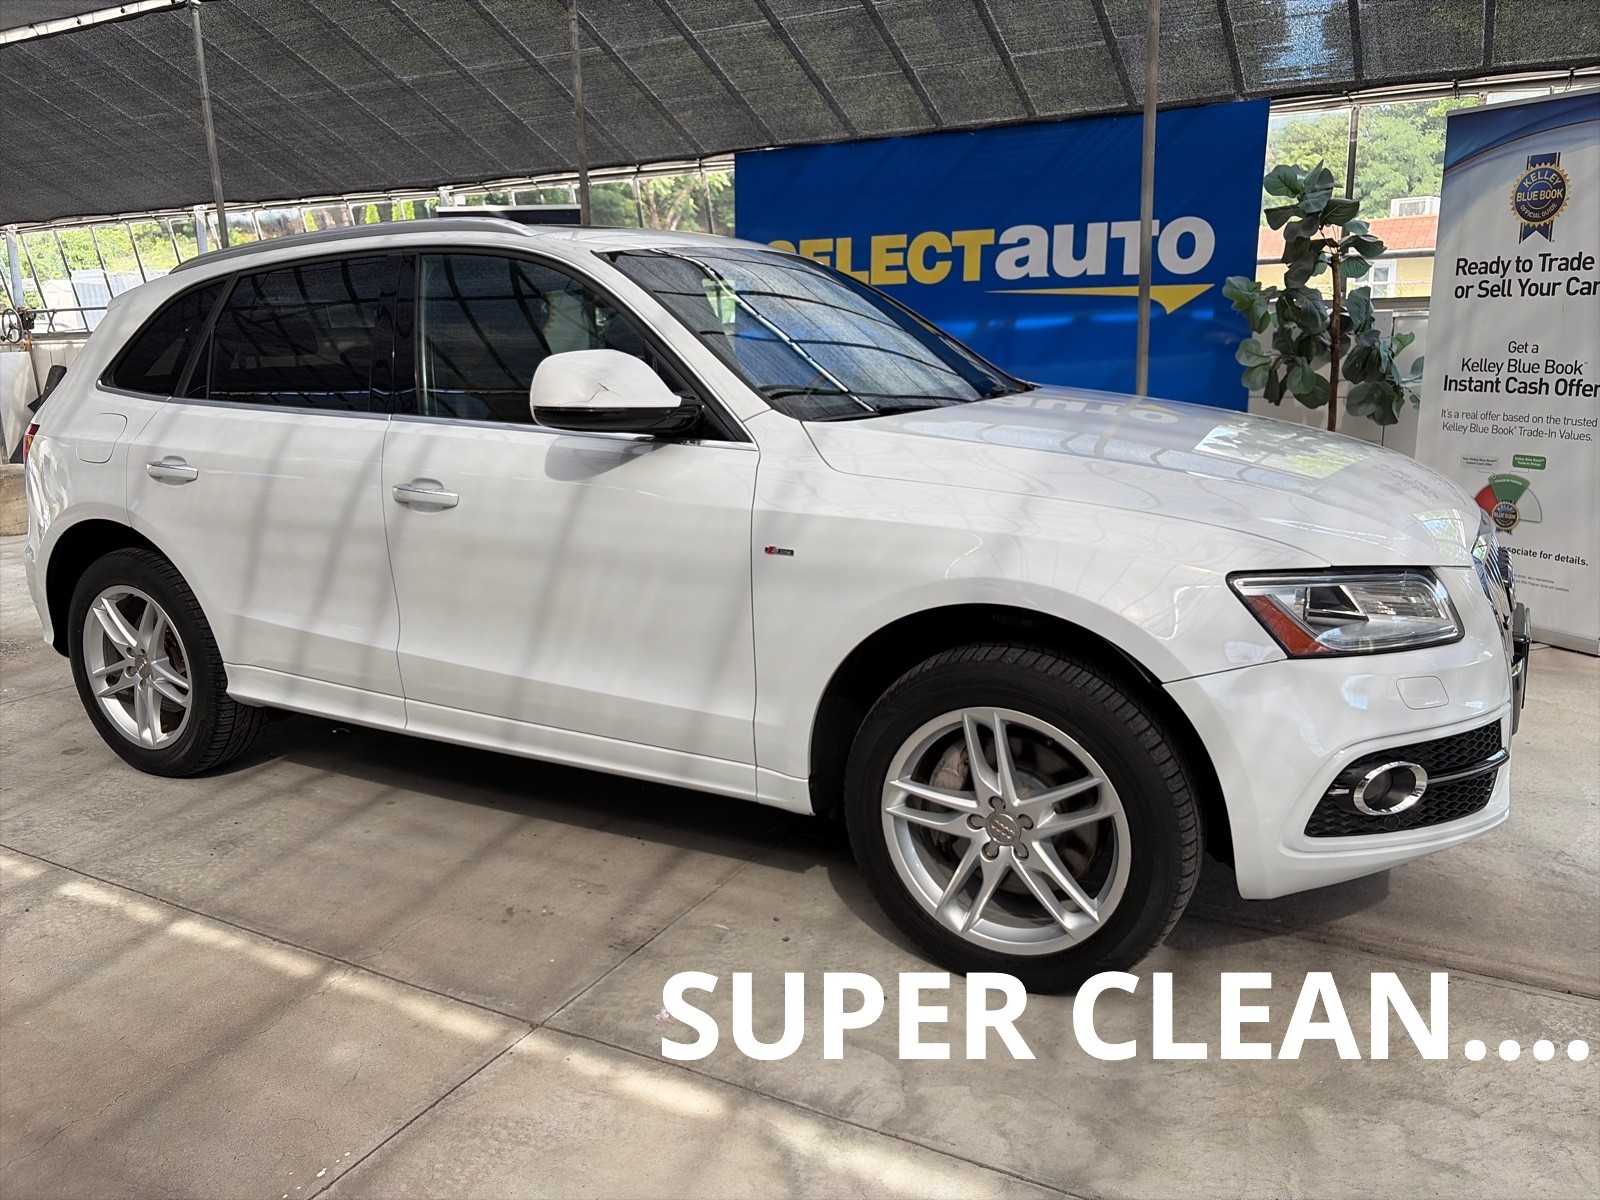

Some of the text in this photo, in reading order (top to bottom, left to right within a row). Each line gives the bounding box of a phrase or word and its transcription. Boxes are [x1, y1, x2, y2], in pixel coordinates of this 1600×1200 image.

[1522, 170, 1562, 188] KELLEY
[1516, 188, 1564, 202] BLUE BOOK
[1520, 202, 1558, 218] OFFICIAL GUIDE
[1455, 251, 1595, 278] Ready to Trade
[1454, 276, 1600, 299] or Sell Your Car
[1508, 341, 1539, 354] Get a
[1461, 358, 1504, 376] Kelley
[1507, 358, 1540, 374] Blue
[1443, 375, 1501, 393] Instant
[1505, 376, 1549, 395] Cash
[1441, 408, 1598, 428] It's a real offer based on the trusted
[1442, 422, 1468, 434] Kelley
[1469, 423, 1490, 434] Blue
[1519, 427, 1557, 439] Trade-In
[1559, 429, 1593, 442] Values.
[1539, 550, 1553, 560] for
[1554, 553, 1589, 567] details.
